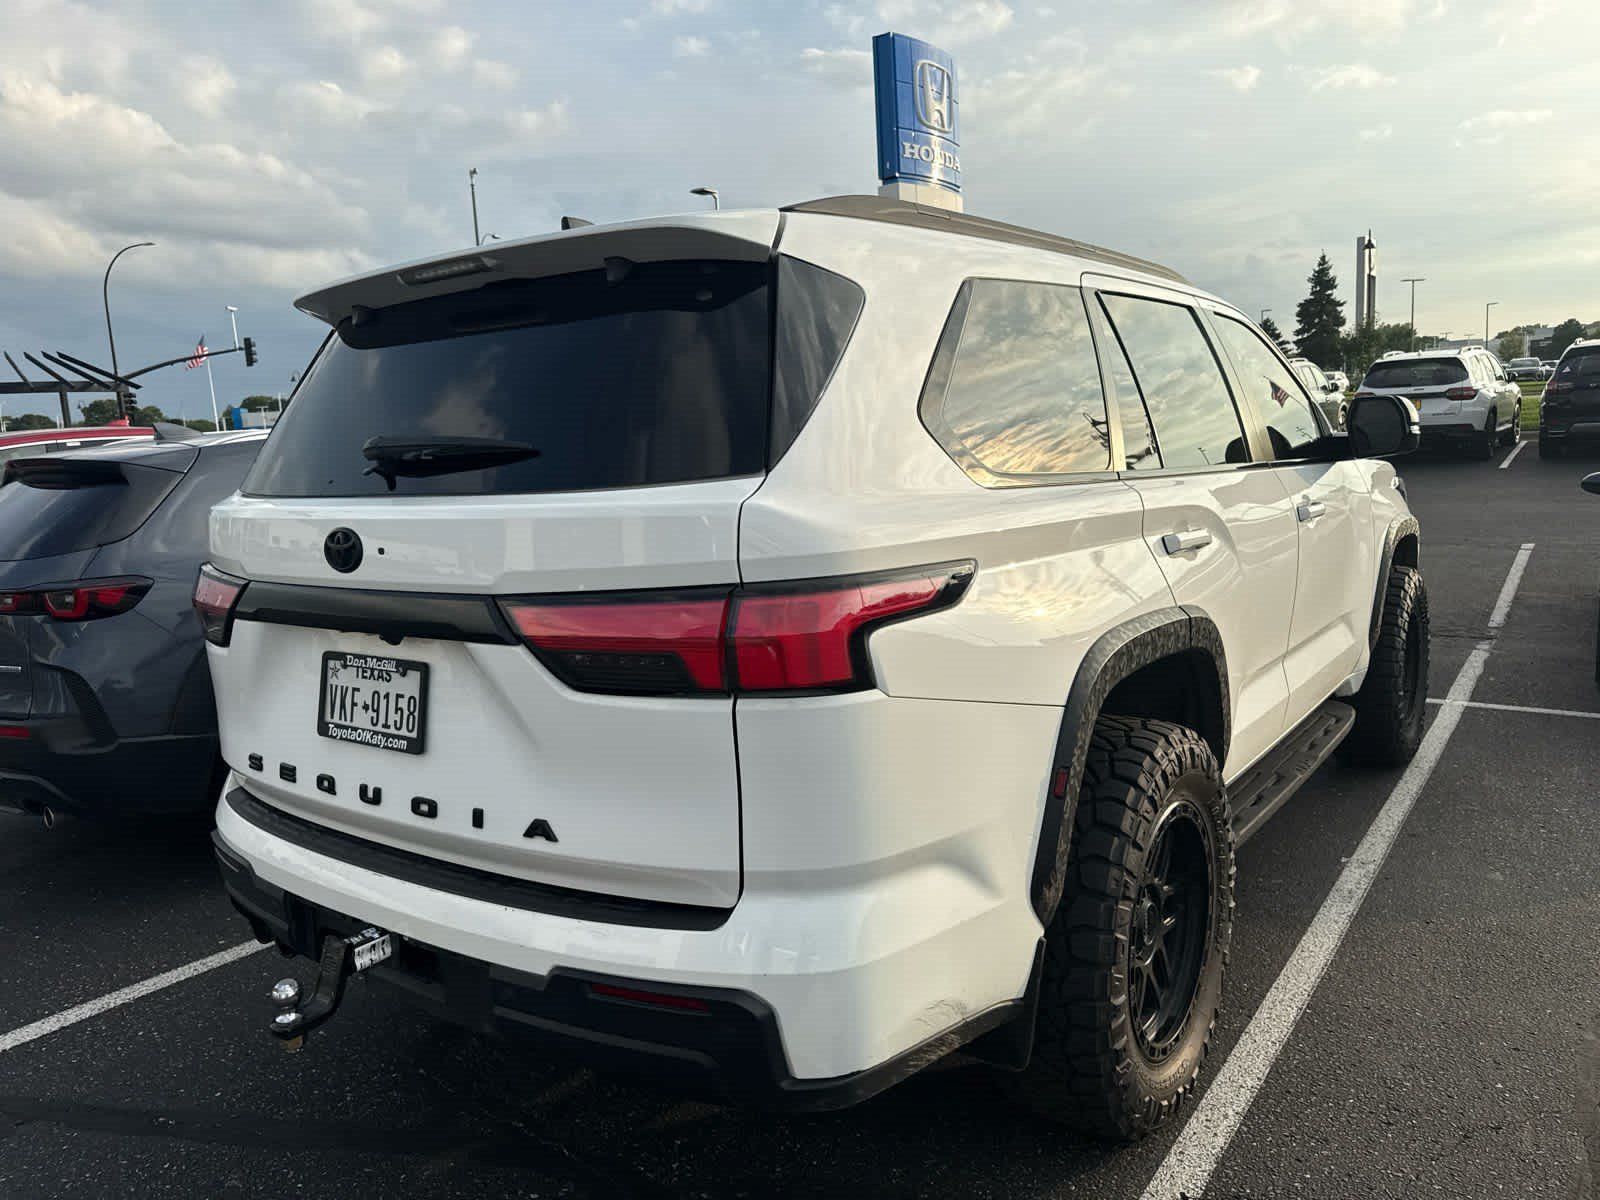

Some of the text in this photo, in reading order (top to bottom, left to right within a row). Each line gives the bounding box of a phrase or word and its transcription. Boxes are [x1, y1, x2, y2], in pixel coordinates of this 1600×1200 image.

[346, 655, 397, 671] Don McGill
[355, 666, 392, 683] TEXAS
[328, 724, 408, 750] ToyotaOfKaty.com
[248, 752, 559, 843] SEQUOIA
